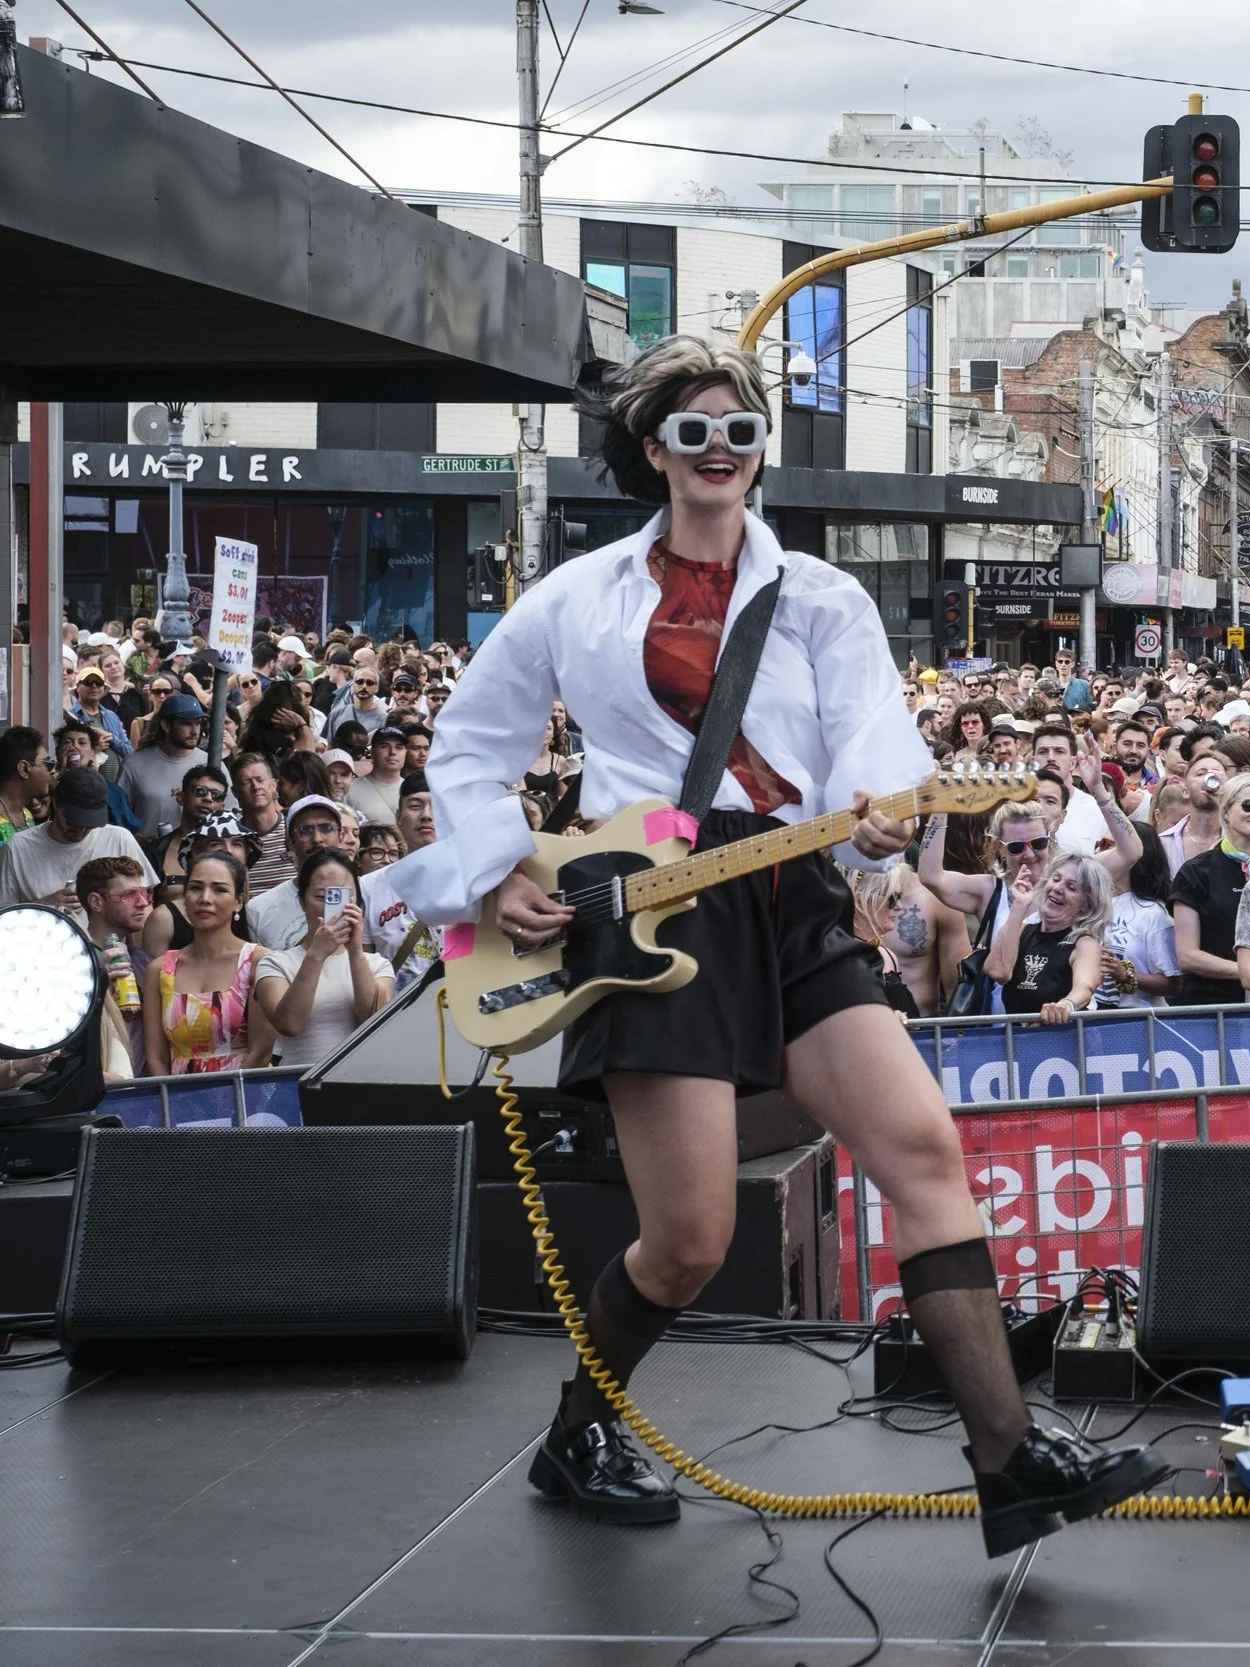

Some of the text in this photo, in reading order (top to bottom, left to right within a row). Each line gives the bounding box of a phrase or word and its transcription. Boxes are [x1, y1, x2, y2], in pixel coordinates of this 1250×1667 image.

[423, 459, 499, 471] GERTRUDE ST
[962, 487, 999, 503] BURNSIDE
[220, 544, 240, 560] Soft
[227, 583, 249, 600] $3.00
[1140, 635, 1155, 647] 30
